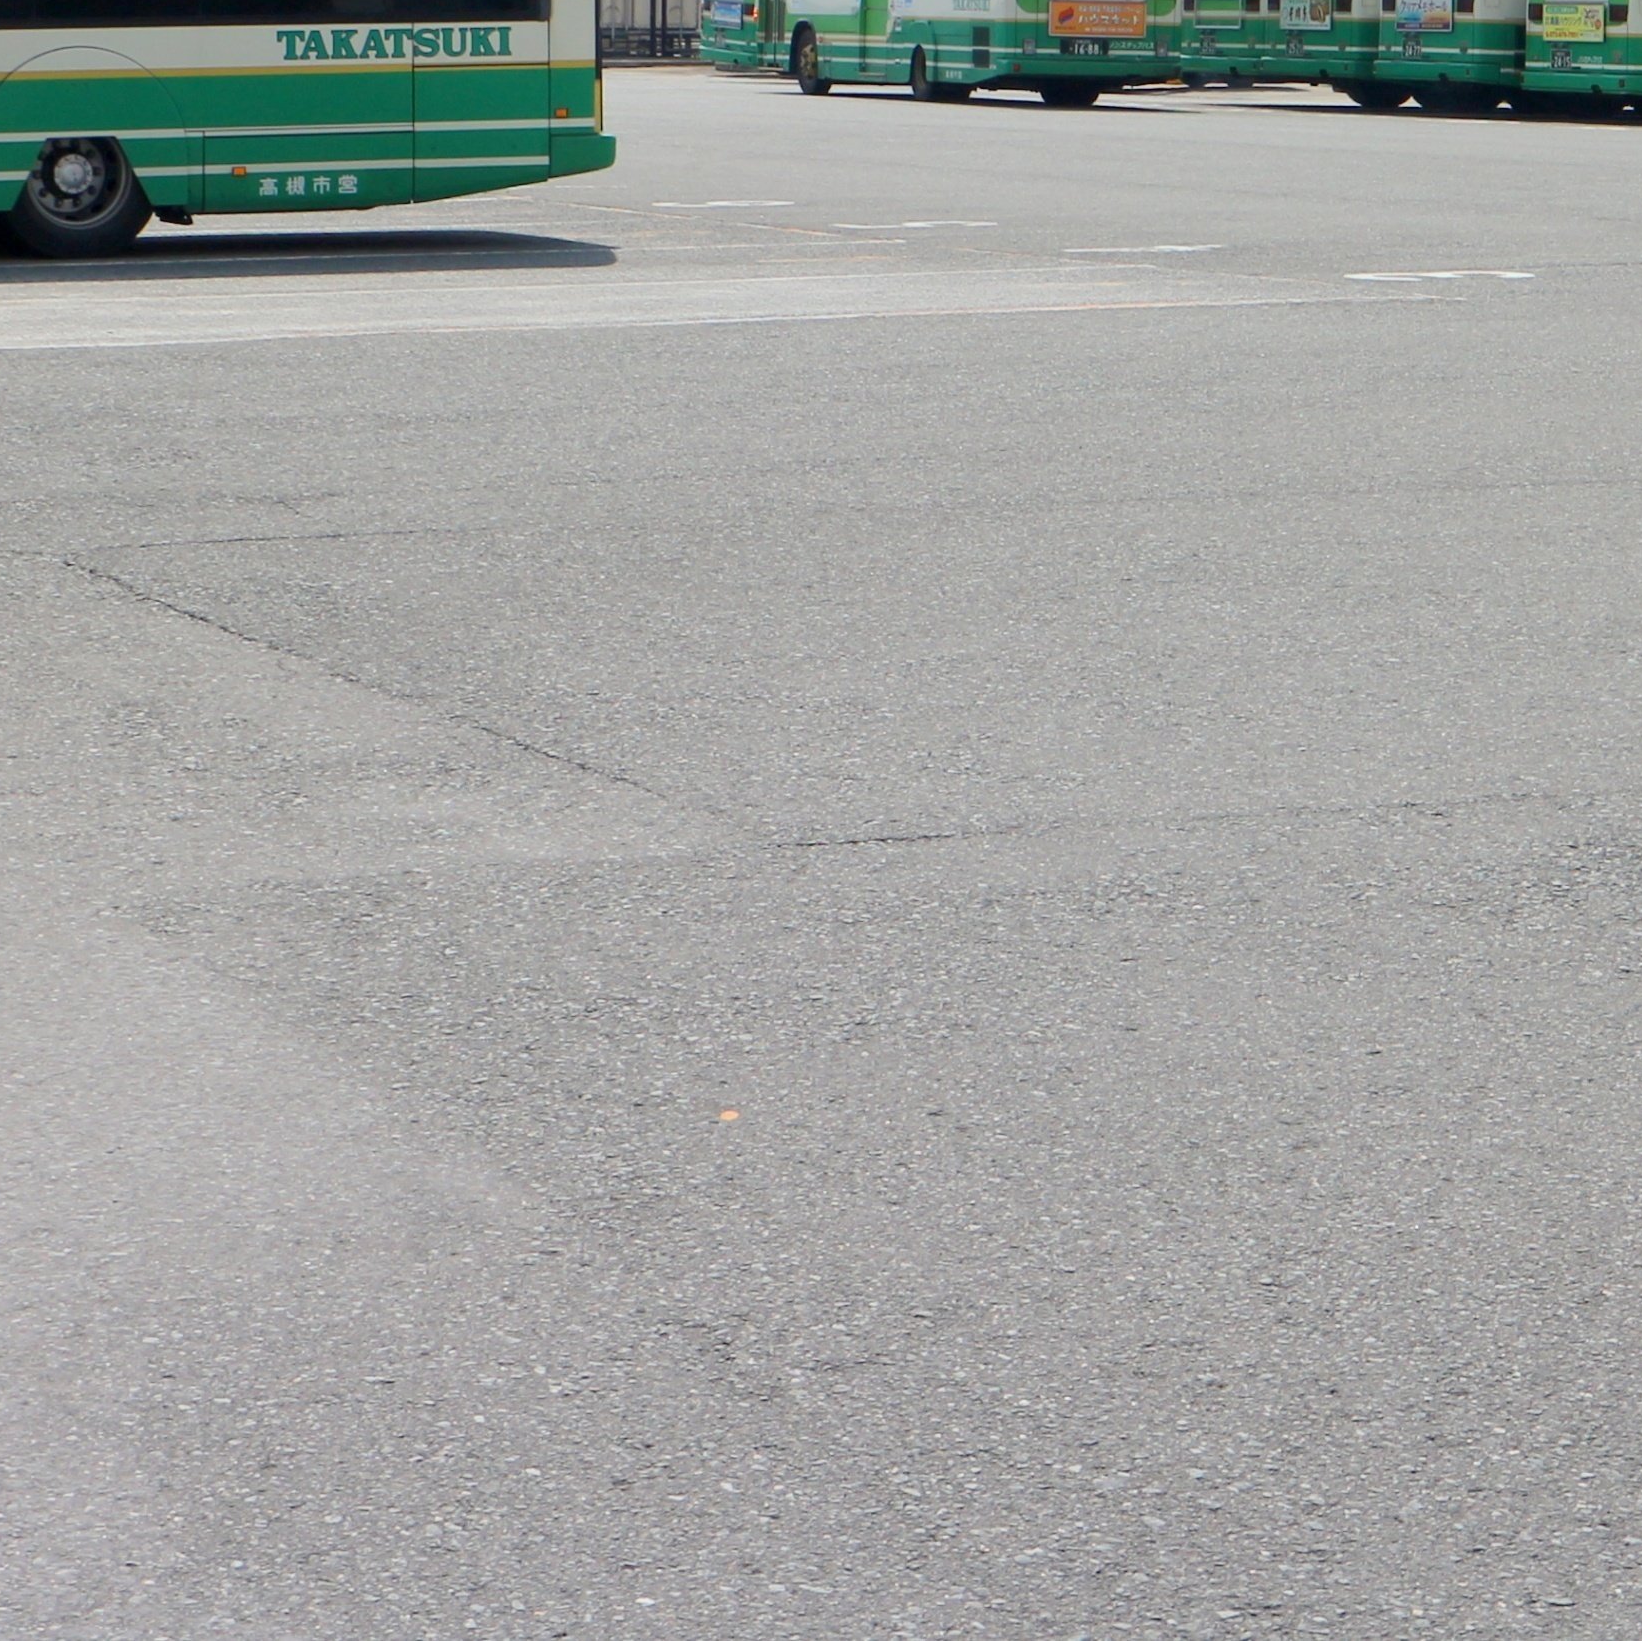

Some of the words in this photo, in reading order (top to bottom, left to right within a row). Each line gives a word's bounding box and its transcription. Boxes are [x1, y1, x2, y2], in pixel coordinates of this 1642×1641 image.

[276, 26, 513, 61] TAKATSUKI
[259, 174, 358, 197] 高槻市営
